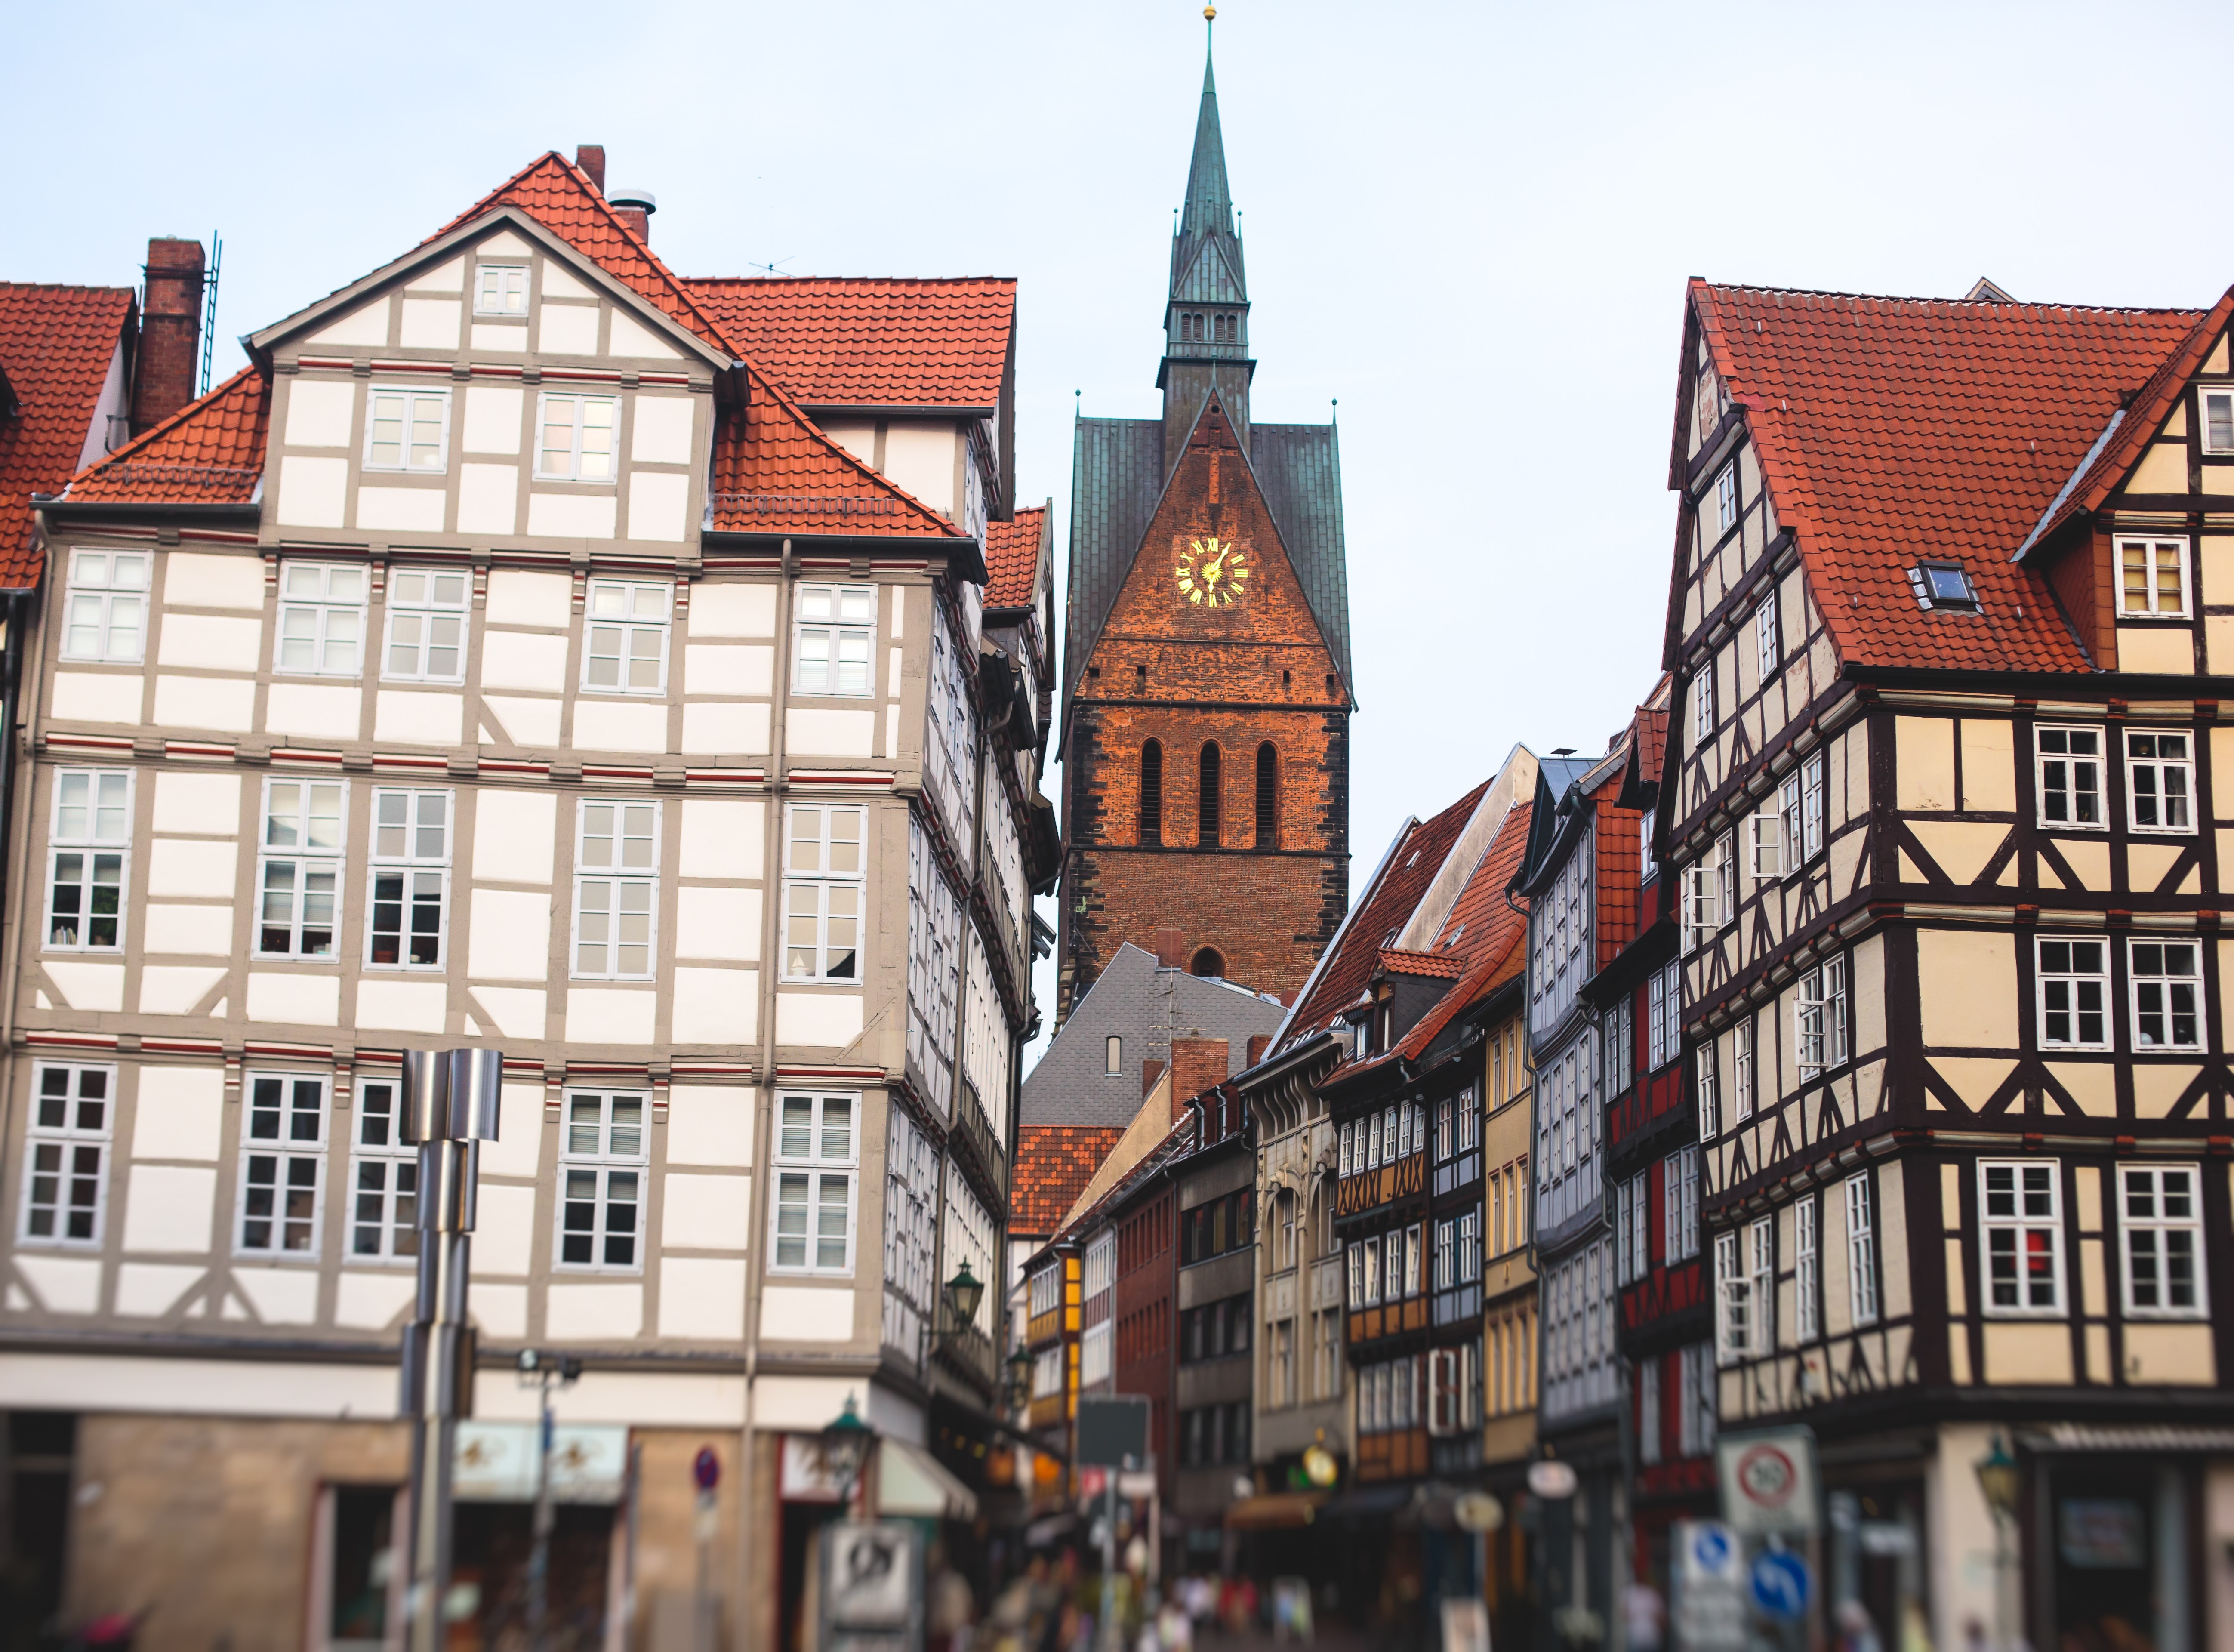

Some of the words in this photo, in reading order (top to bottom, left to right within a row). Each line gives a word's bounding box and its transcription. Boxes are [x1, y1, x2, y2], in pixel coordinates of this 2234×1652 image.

[1191, 540, 1205, 555] XI
[1207, 537, 1218, 552] XII
[1180, 551, 1194, 563] X
[1230, 554, 1245, 564] II
[1234, 569, 1248, 578] III
